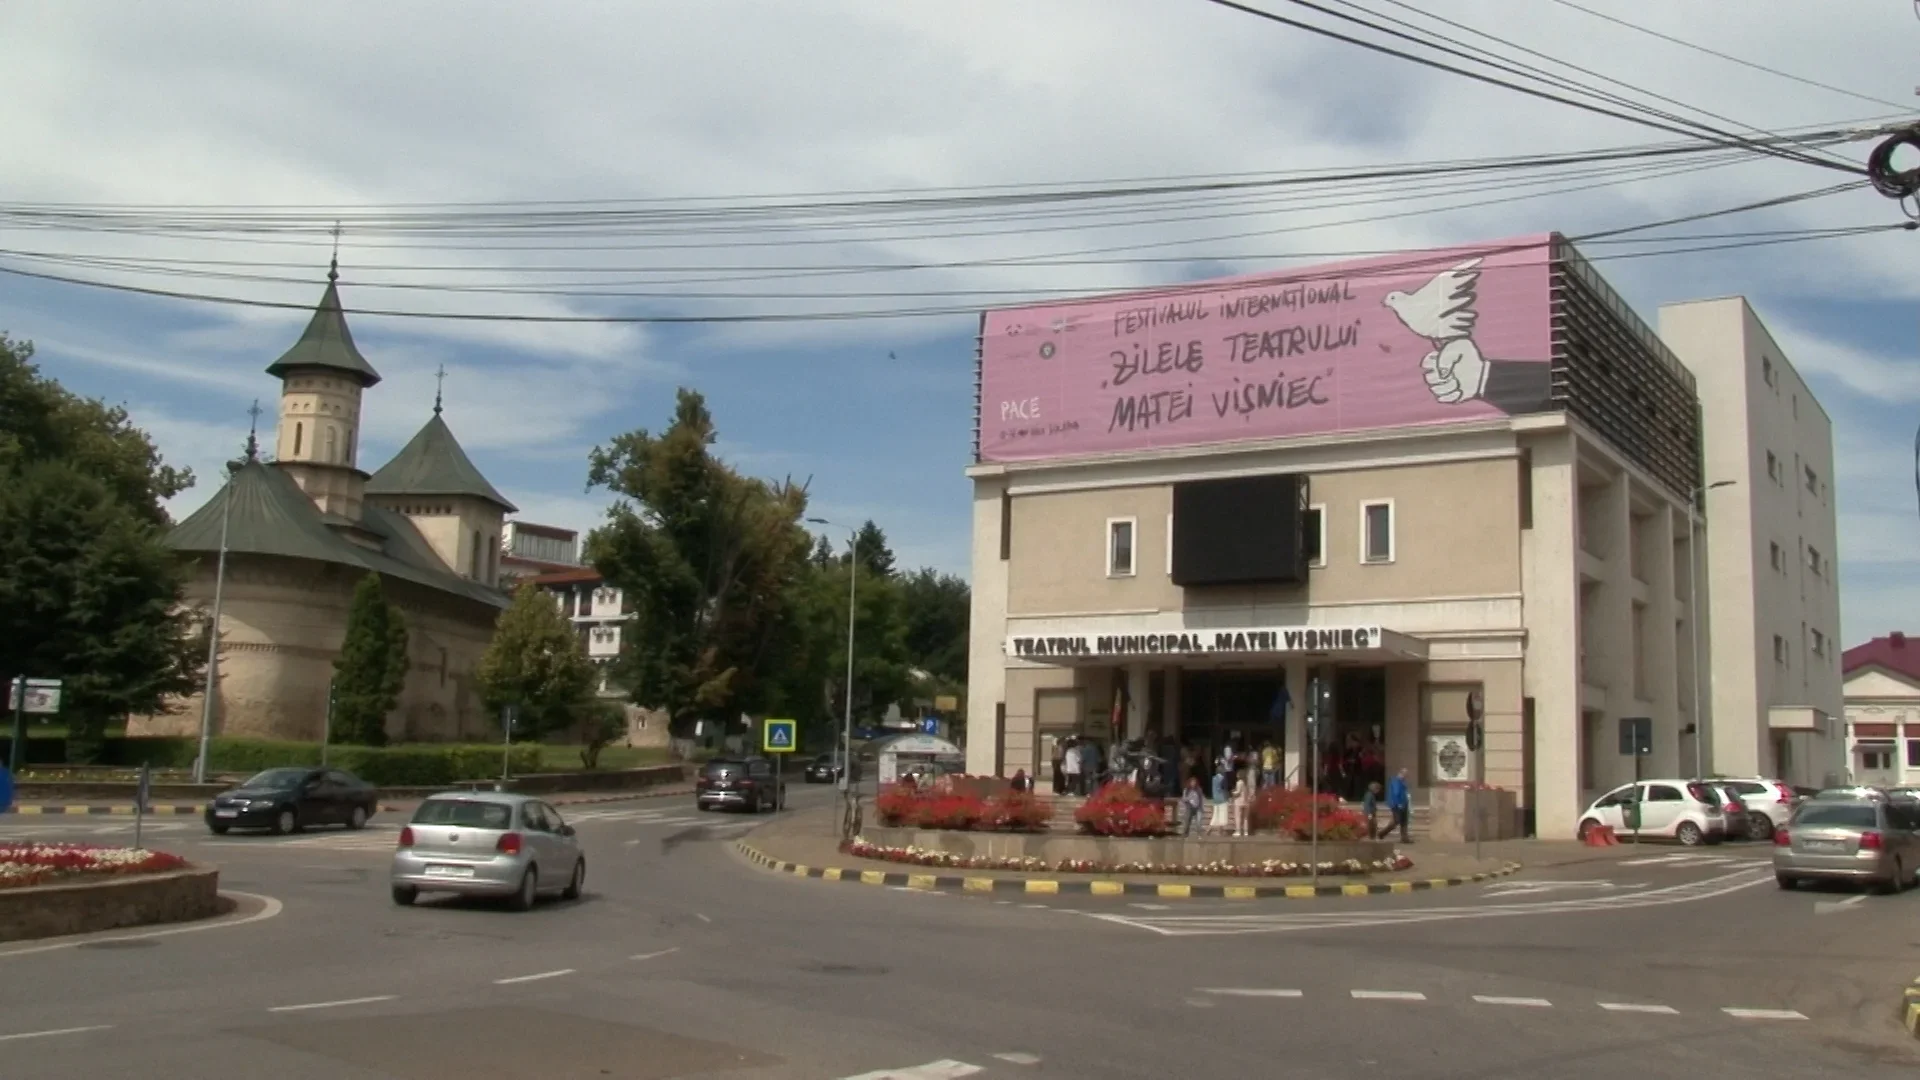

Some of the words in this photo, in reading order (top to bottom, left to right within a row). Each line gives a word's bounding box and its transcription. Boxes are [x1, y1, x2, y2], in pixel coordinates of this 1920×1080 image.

[1114, 299, 1209, 337] FESTIVALUL
[1000, 396, 1041, 421] PACE
[1108, 382, 1193, 434] MATEI
[1013, 637, 1091, 655] TEATRUL
[1096, 633, 1203, 654] MUNICIPAL
